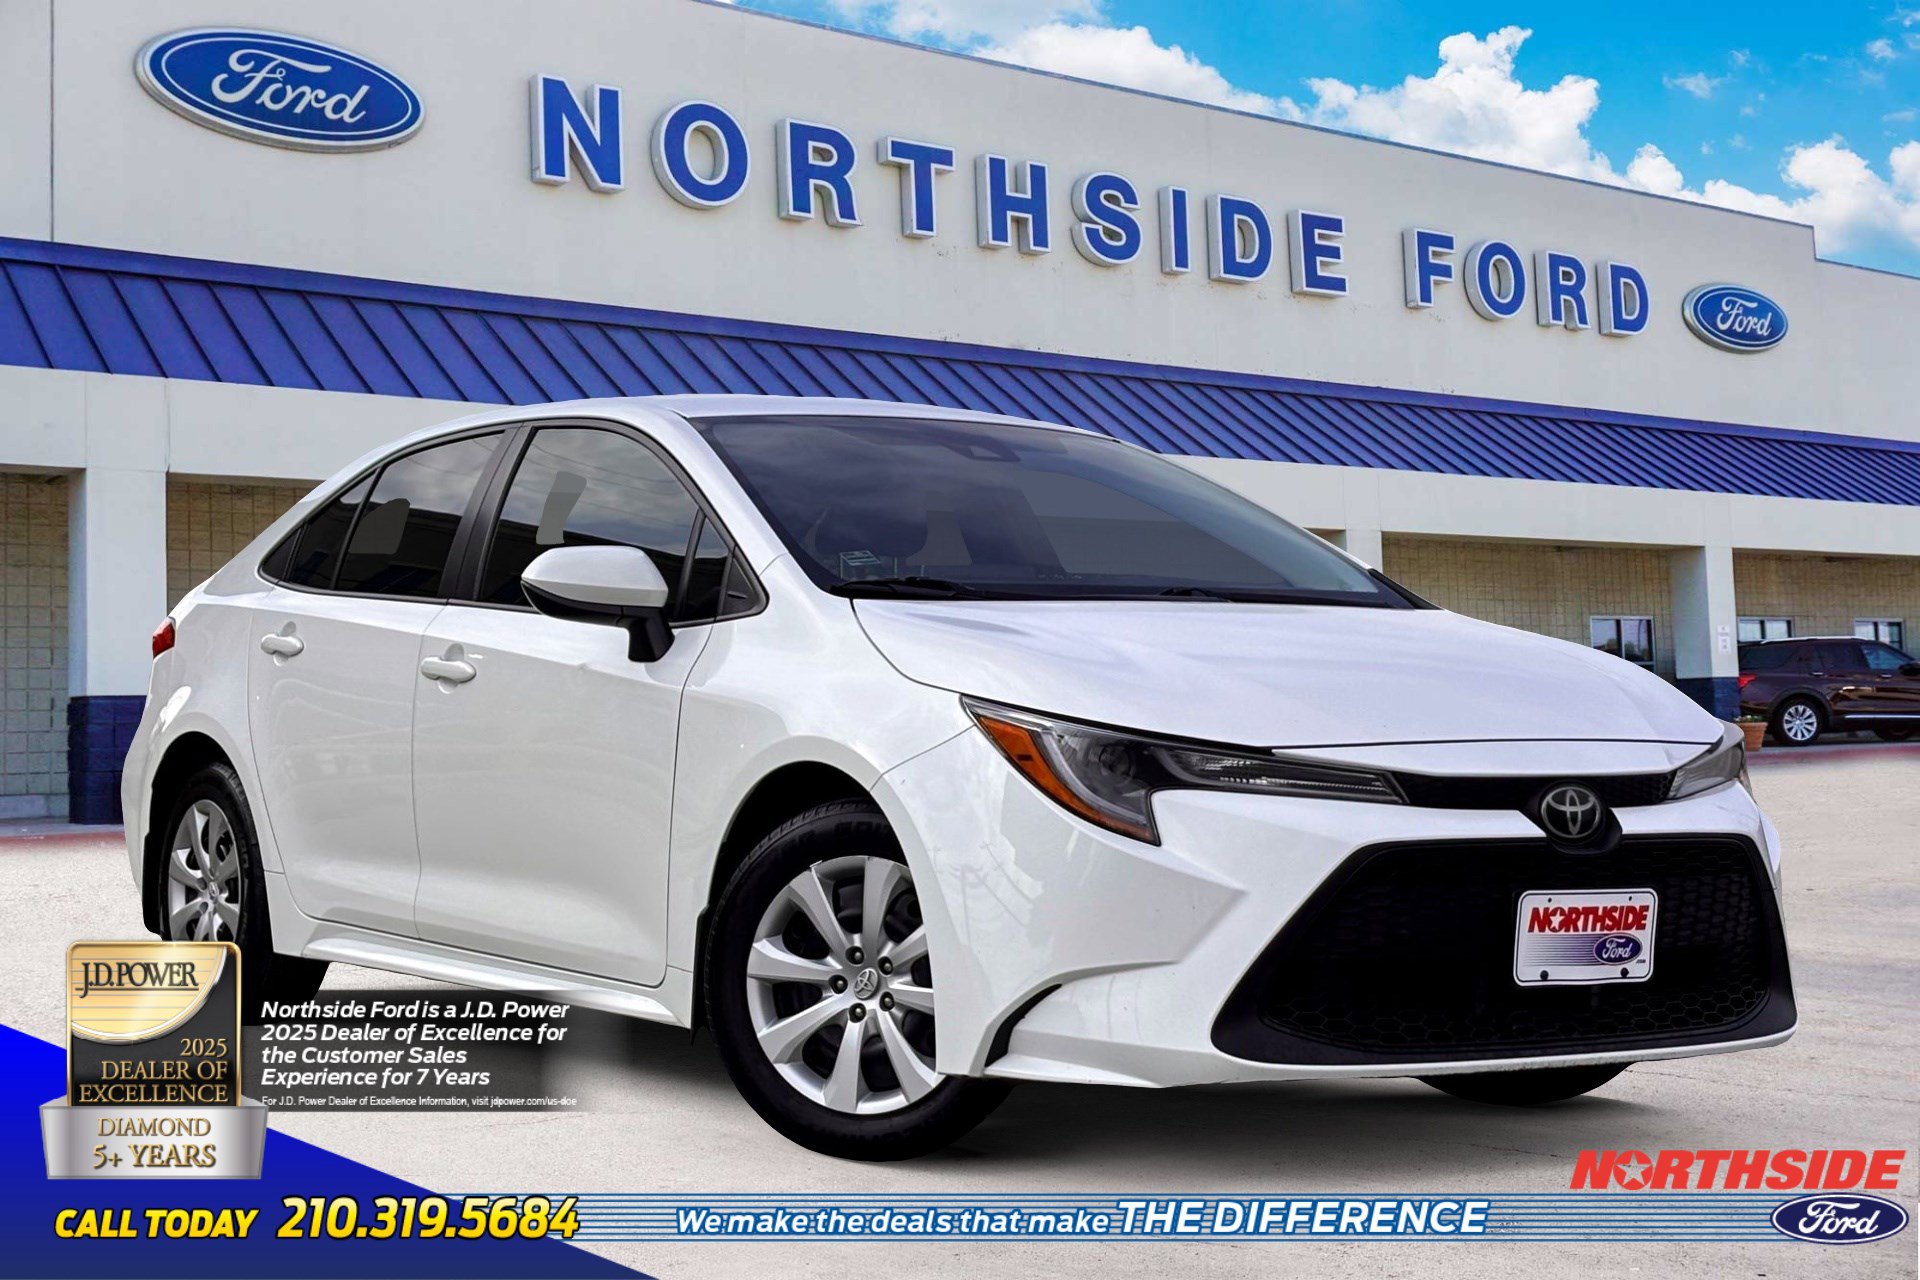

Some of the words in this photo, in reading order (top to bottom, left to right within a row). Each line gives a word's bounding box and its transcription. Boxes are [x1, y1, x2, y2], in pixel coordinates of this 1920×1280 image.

[211, 48, 370, 125] Ford
[529, 73, 1349, 298] NORTHSIDE
[1403, 226, 1650, 338] FORD
[1715, 293, 1771, 337] Ford
[1528, 905, 1649, 933] NORTHSIDE
[1602, 938, 1632, 958] Ford
